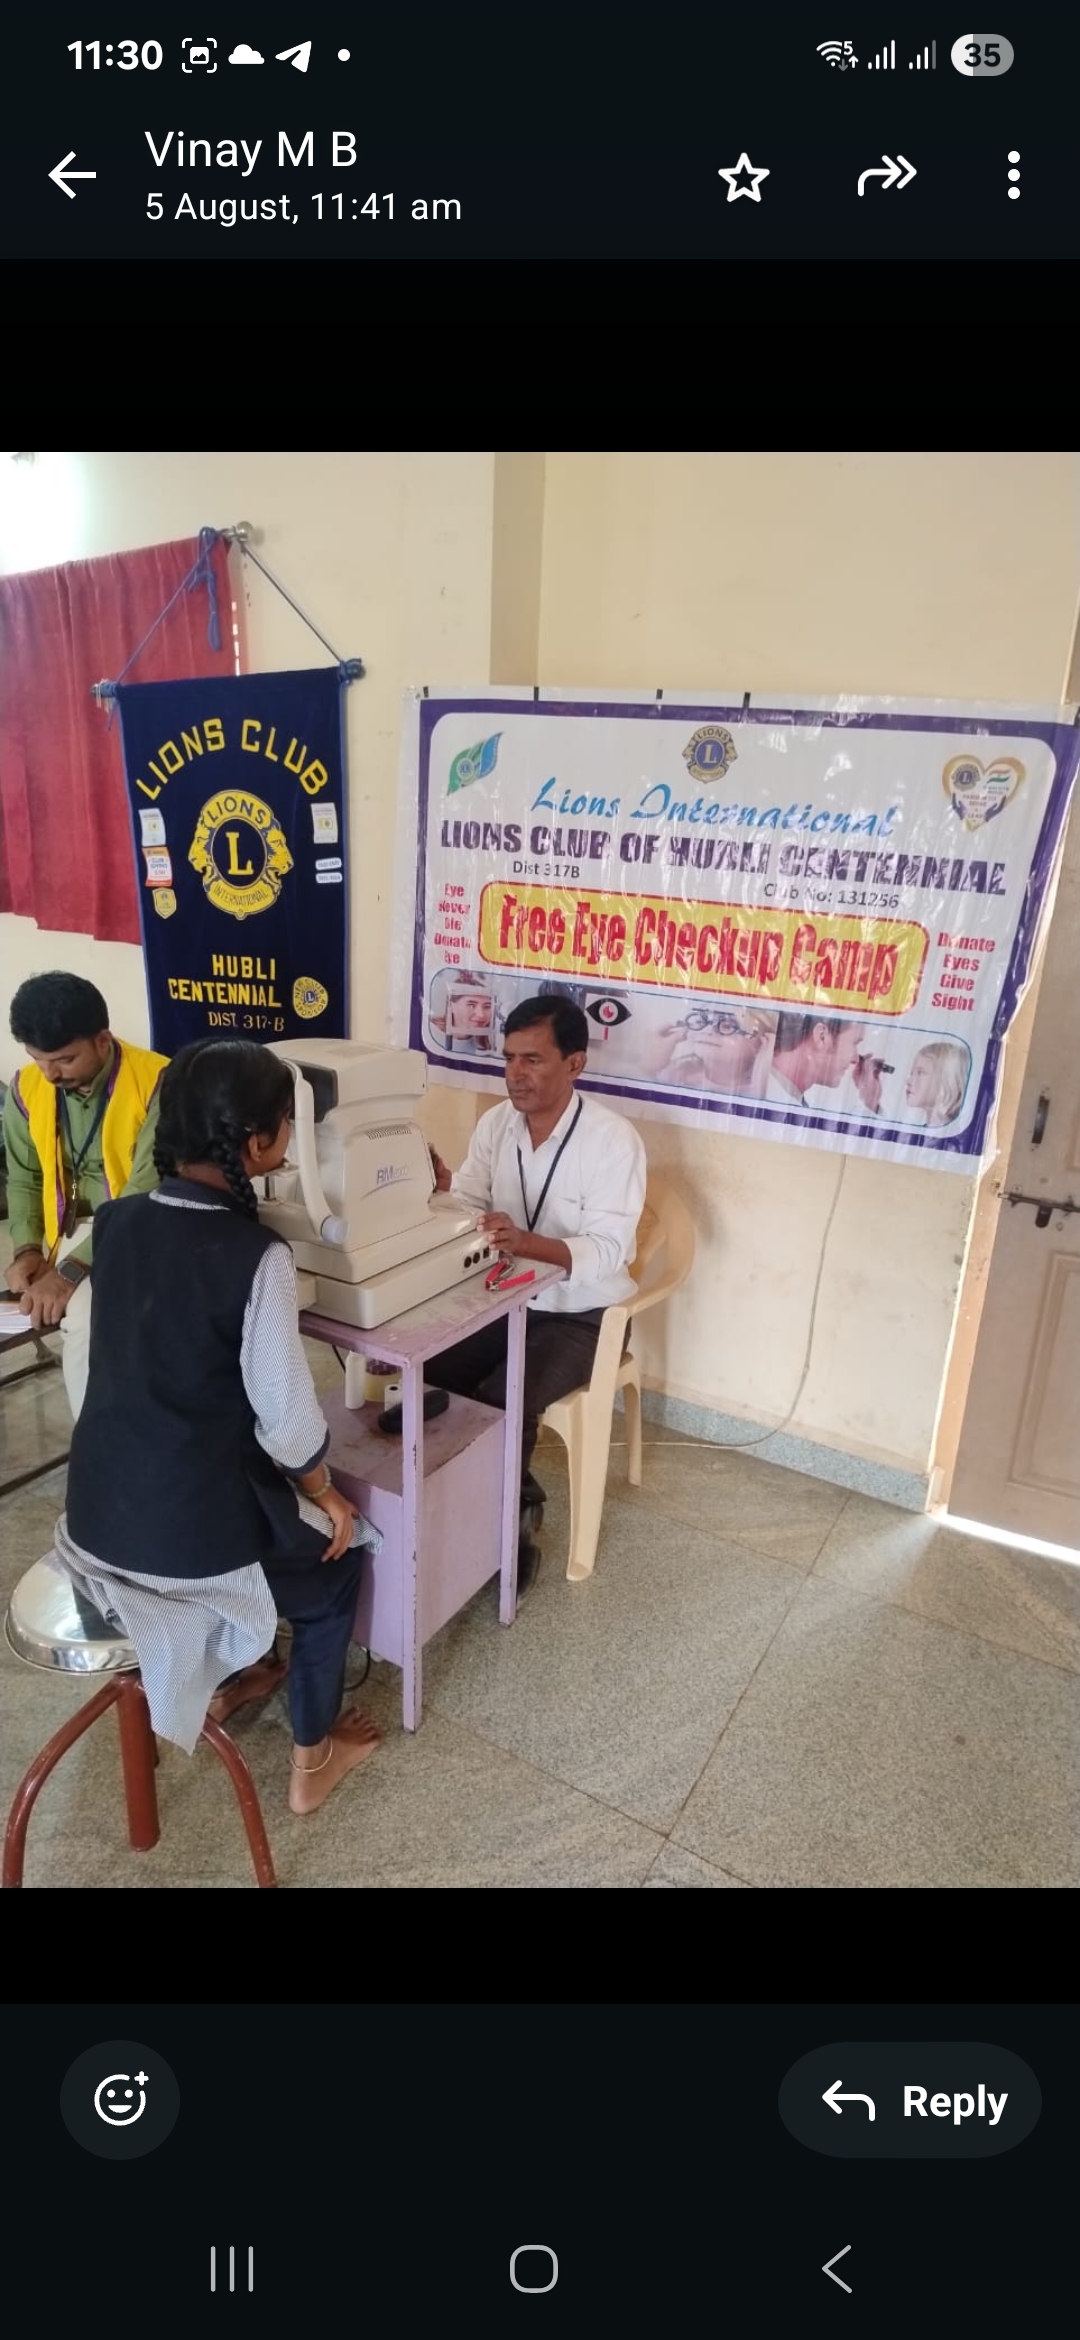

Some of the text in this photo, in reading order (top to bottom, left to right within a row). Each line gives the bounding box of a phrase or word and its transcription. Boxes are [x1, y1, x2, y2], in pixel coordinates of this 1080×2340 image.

[697, 728, 729, 741] LIONS
[136, 718, 328, 800] LIONS CLUB
[703, 745, 717, 763] L
[207, 796, 266, 824] LIONS
[530, 777, 898, 838] Lions International
[226, 832, 254, 875] L
[441, 819, 522, 853] LIONS
[530, 826, 610, 859] CLUB
[620, 832, 661, 864] OF
[780, 844, 1006, 896] CENTENNIAL
[513, 860, 580, 878] Dist 317B
[445, 883, 464, 897] Eye
[838, 889, 899, 908] 131256
[500, 894, 898, 1000] Free Eye Checkup Camp
[212, 954, 276, 980] HUBLI
[943, 954, 980, 971] Eyes
[168, 978, 282, 1008] CENTENNIAL
[940, 974, 974, 991] Give
[932, 992, 974, 1011] Sight
